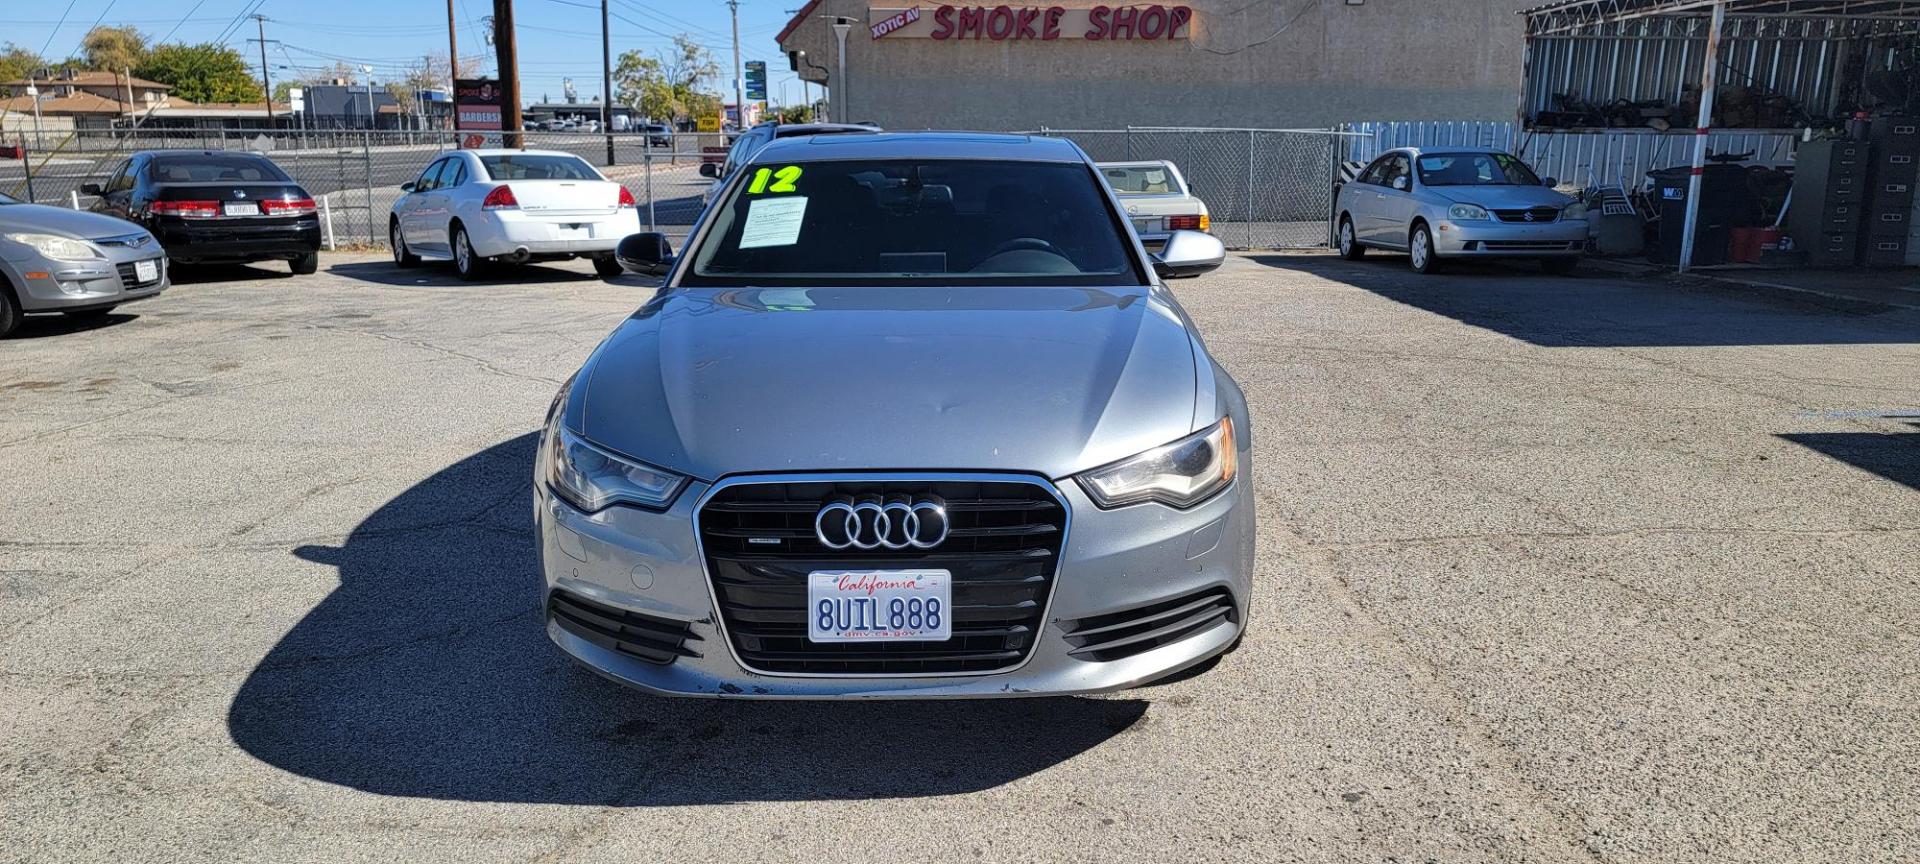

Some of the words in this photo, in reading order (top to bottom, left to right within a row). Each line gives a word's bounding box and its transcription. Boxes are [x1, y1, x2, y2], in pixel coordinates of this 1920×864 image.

[871, 14, 905, 39] XOTIC
[905, 7, 920, 23] AV
[930, 5, 1066, 41] SMOKE
[1084, 4, 1193, 41] SHOP
[747, 165, 804, 194] 12
[838, 574, 924, 596] California
[817, 597, 942, 632] 8UIL888
[844, 630, 916, 638] dmv.ca.gov
